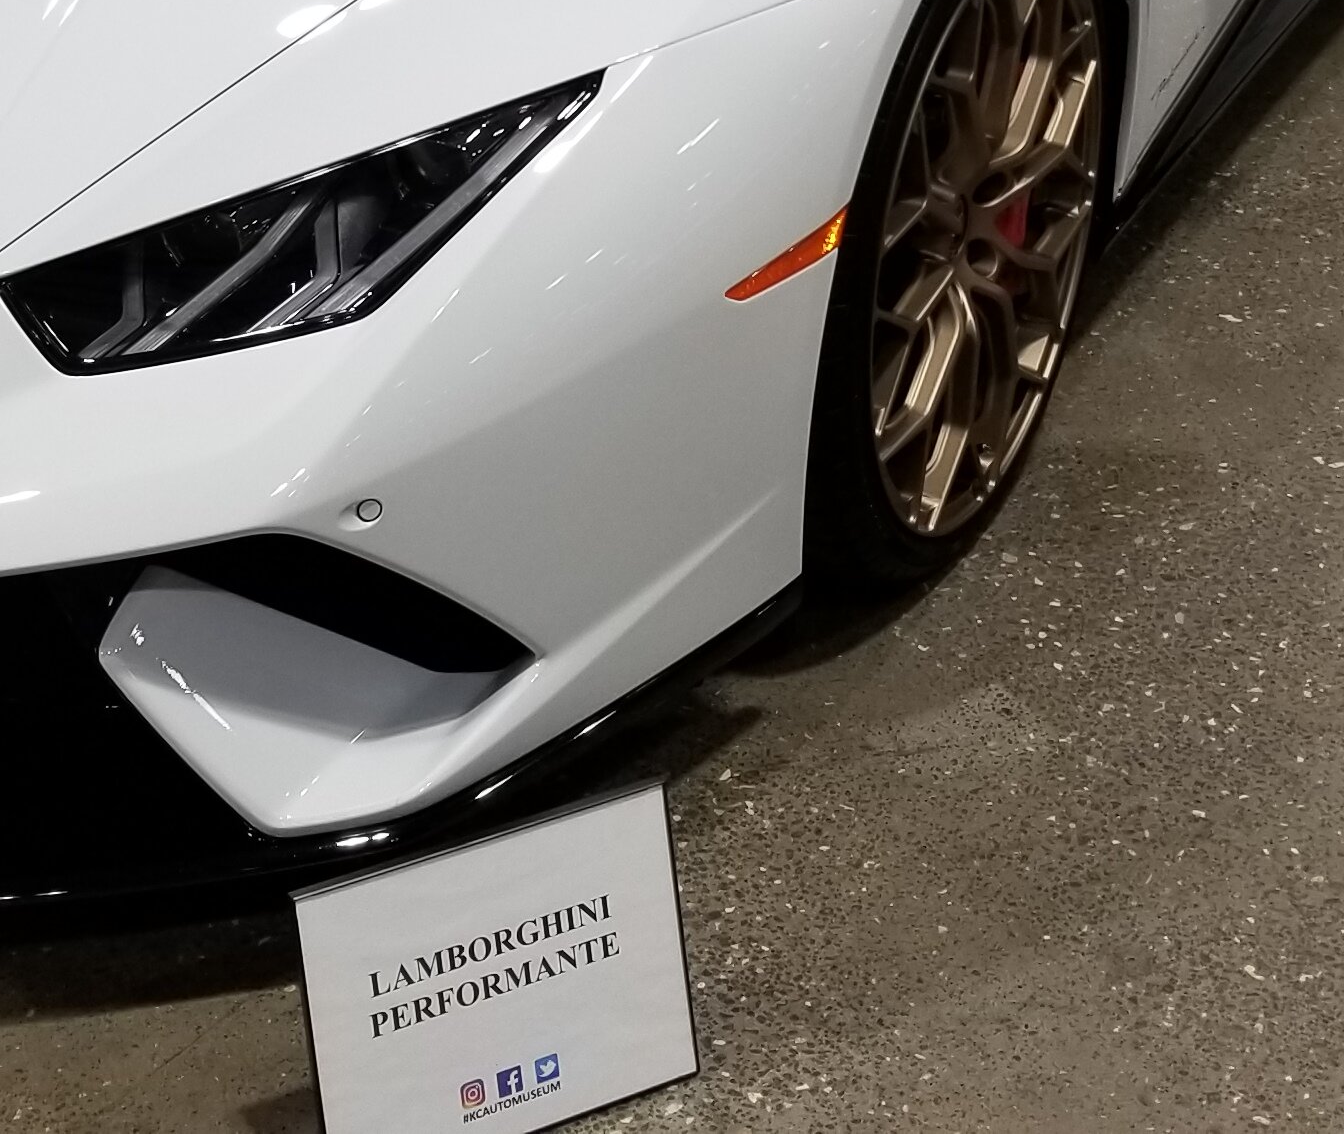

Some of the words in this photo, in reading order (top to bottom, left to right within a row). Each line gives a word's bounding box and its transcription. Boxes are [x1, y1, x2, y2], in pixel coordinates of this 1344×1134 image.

[369, 894, 612, 998] LAMBORGHINI
[369, 931, 620, 1038] PERFORMANTE
[463, 1081, 561, 1124] #KCAUTOMUSEUM
